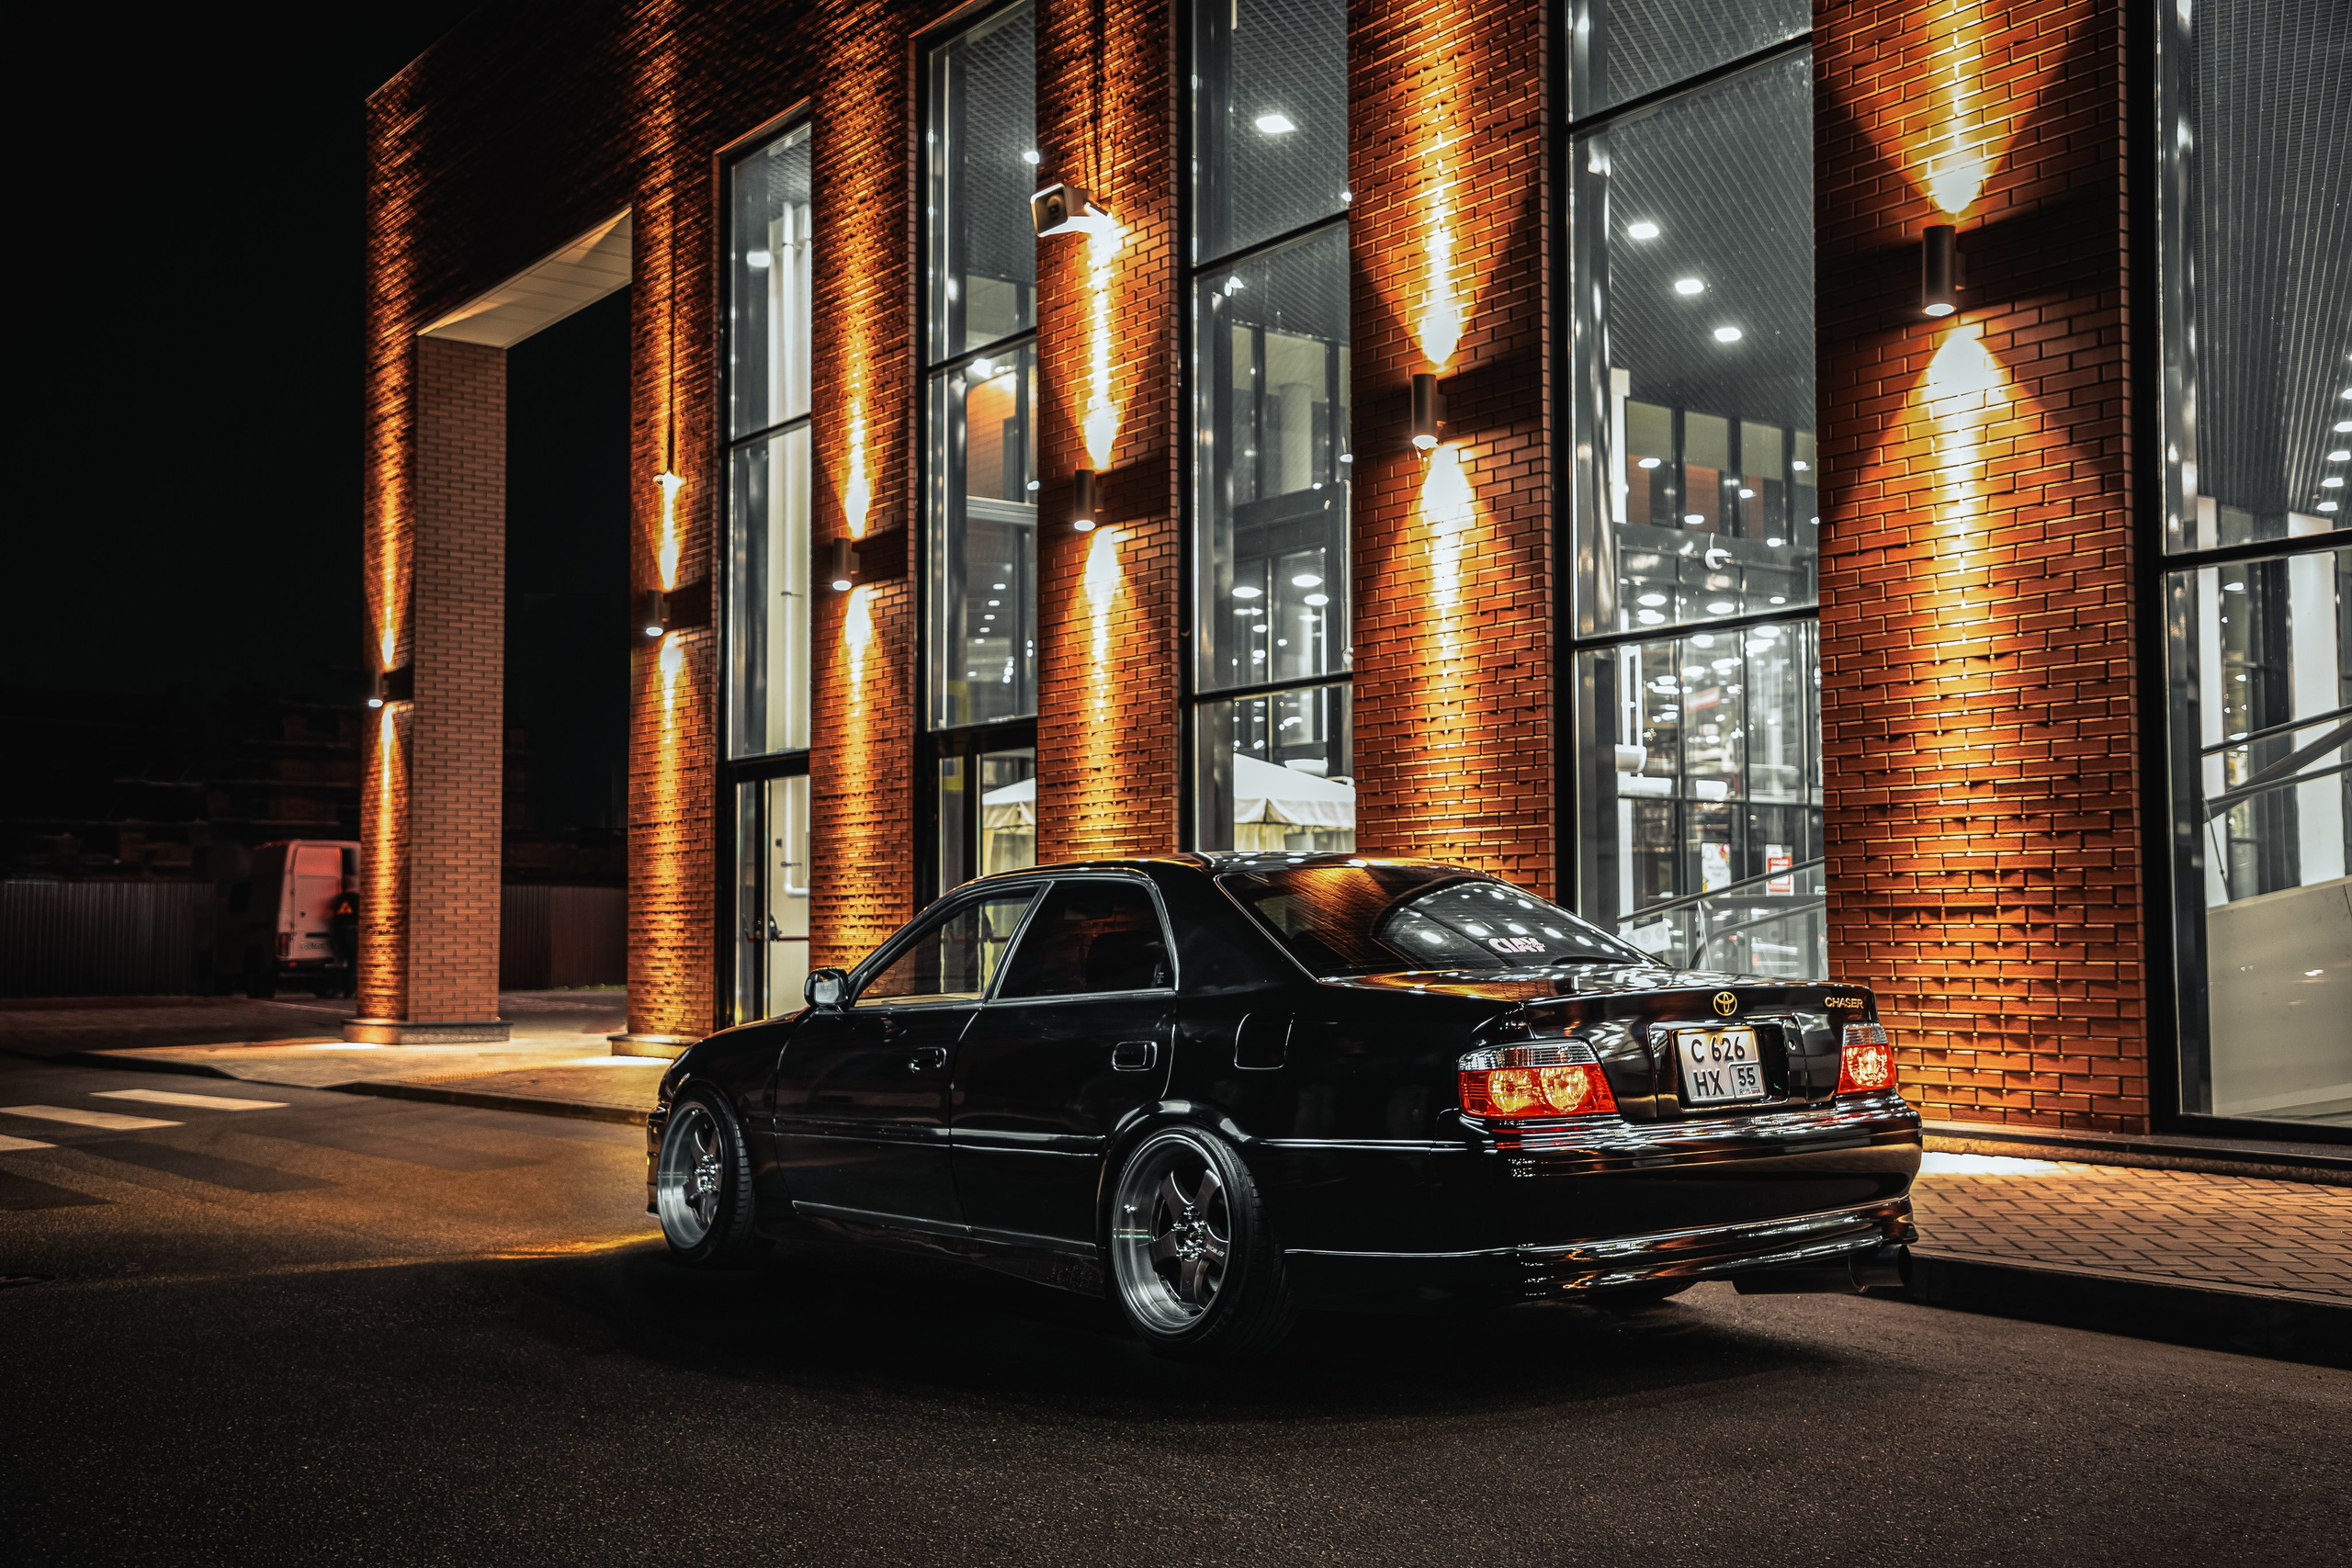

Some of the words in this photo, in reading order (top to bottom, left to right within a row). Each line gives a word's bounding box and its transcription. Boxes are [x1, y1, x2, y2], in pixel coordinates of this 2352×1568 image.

[1824, 997, 1864, 1010] CHASER
[1690, 1039, 1704, 1063] C
[1711, 1035, 1746, 1062] 626
[1692, 1069, 1724, 1097] HX
[1736, 1066, 1756, 1086] 55
